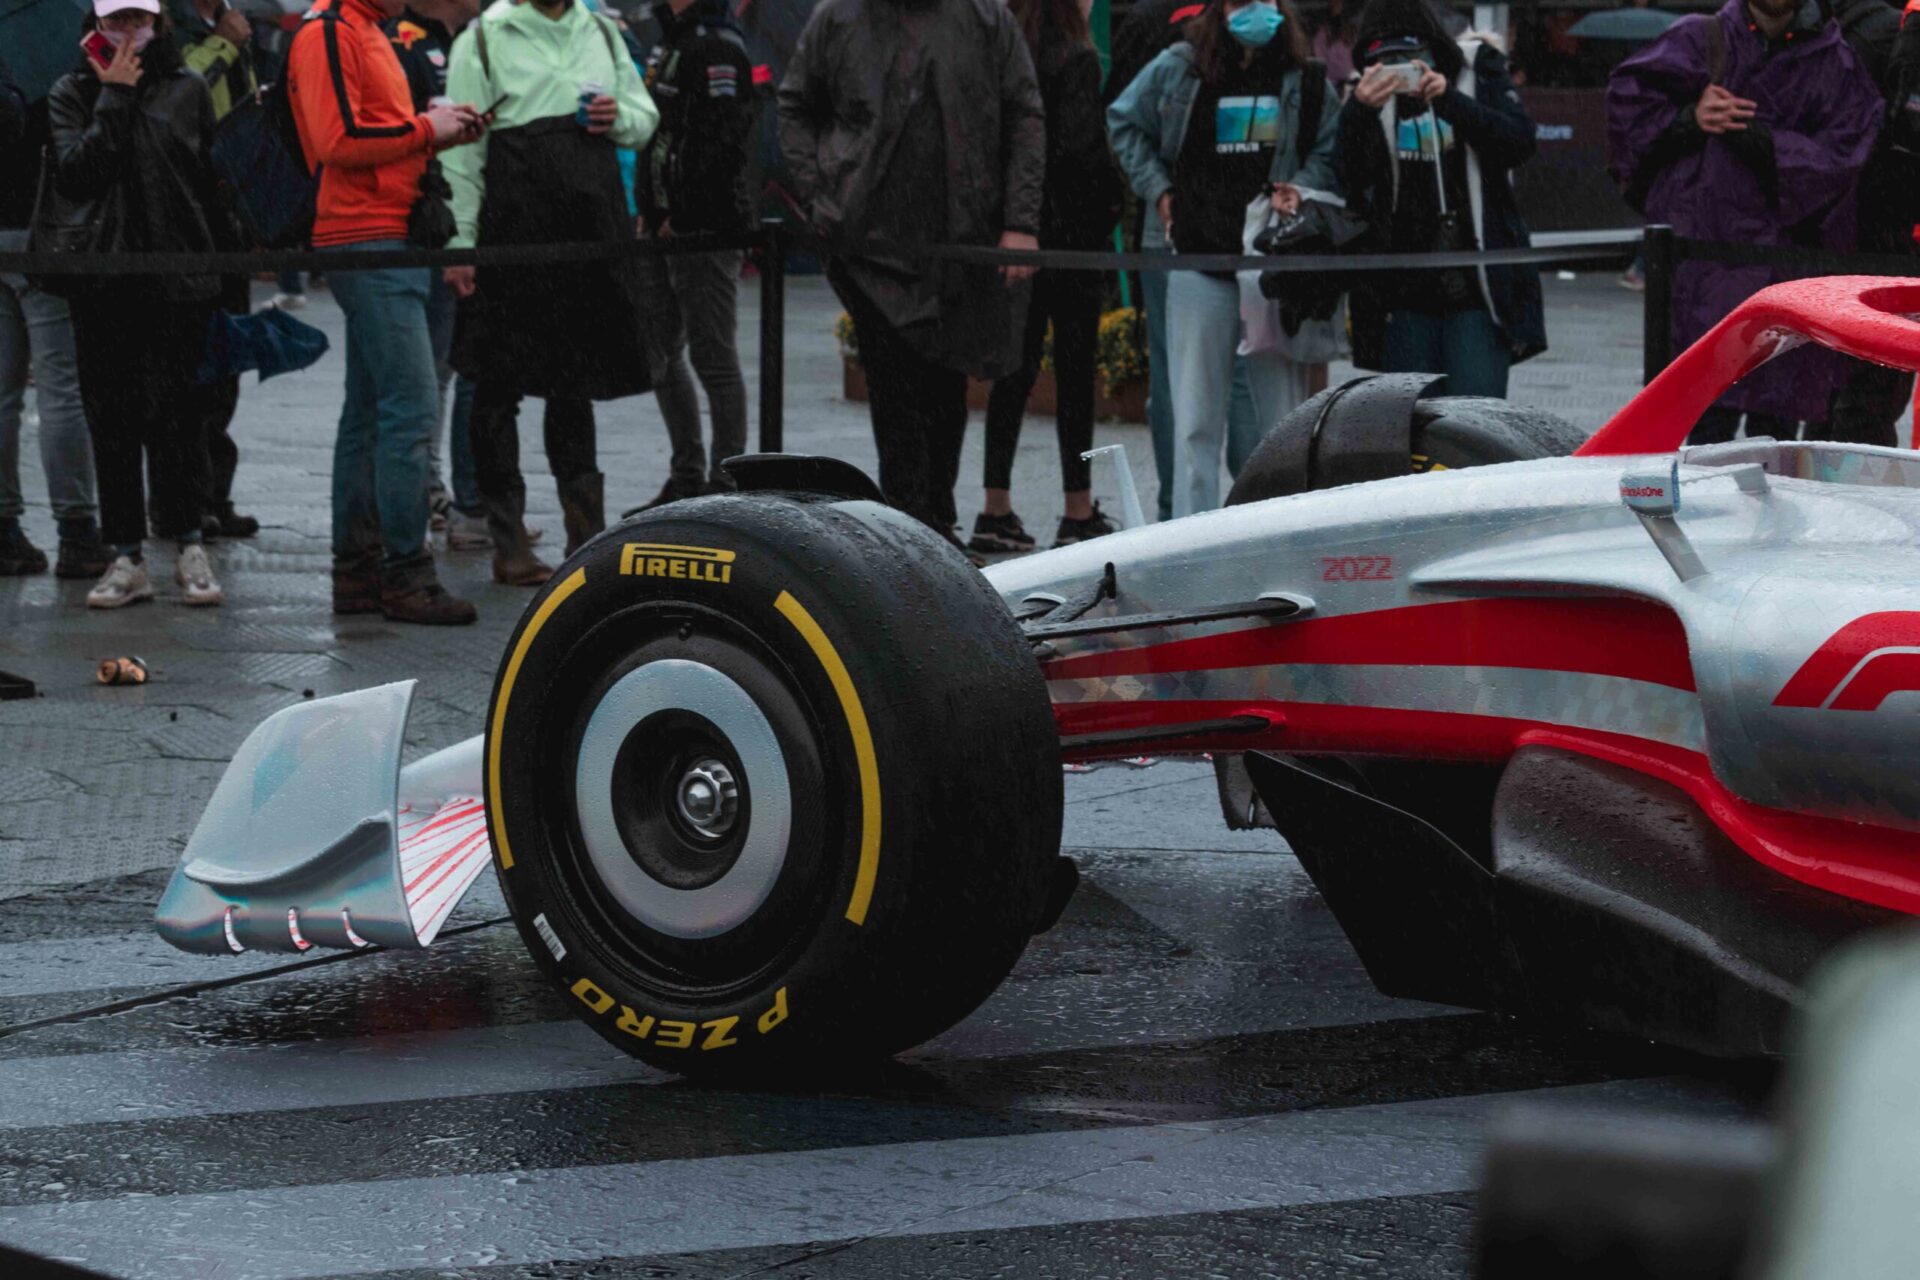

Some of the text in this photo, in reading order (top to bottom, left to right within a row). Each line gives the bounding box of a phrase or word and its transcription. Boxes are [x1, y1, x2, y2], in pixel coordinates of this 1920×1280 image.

[620, 543, 736, 583] PIRELLI
[1321, 555, 1393, 582] 2022
[570, 978, 788, 1050] P ZERO
